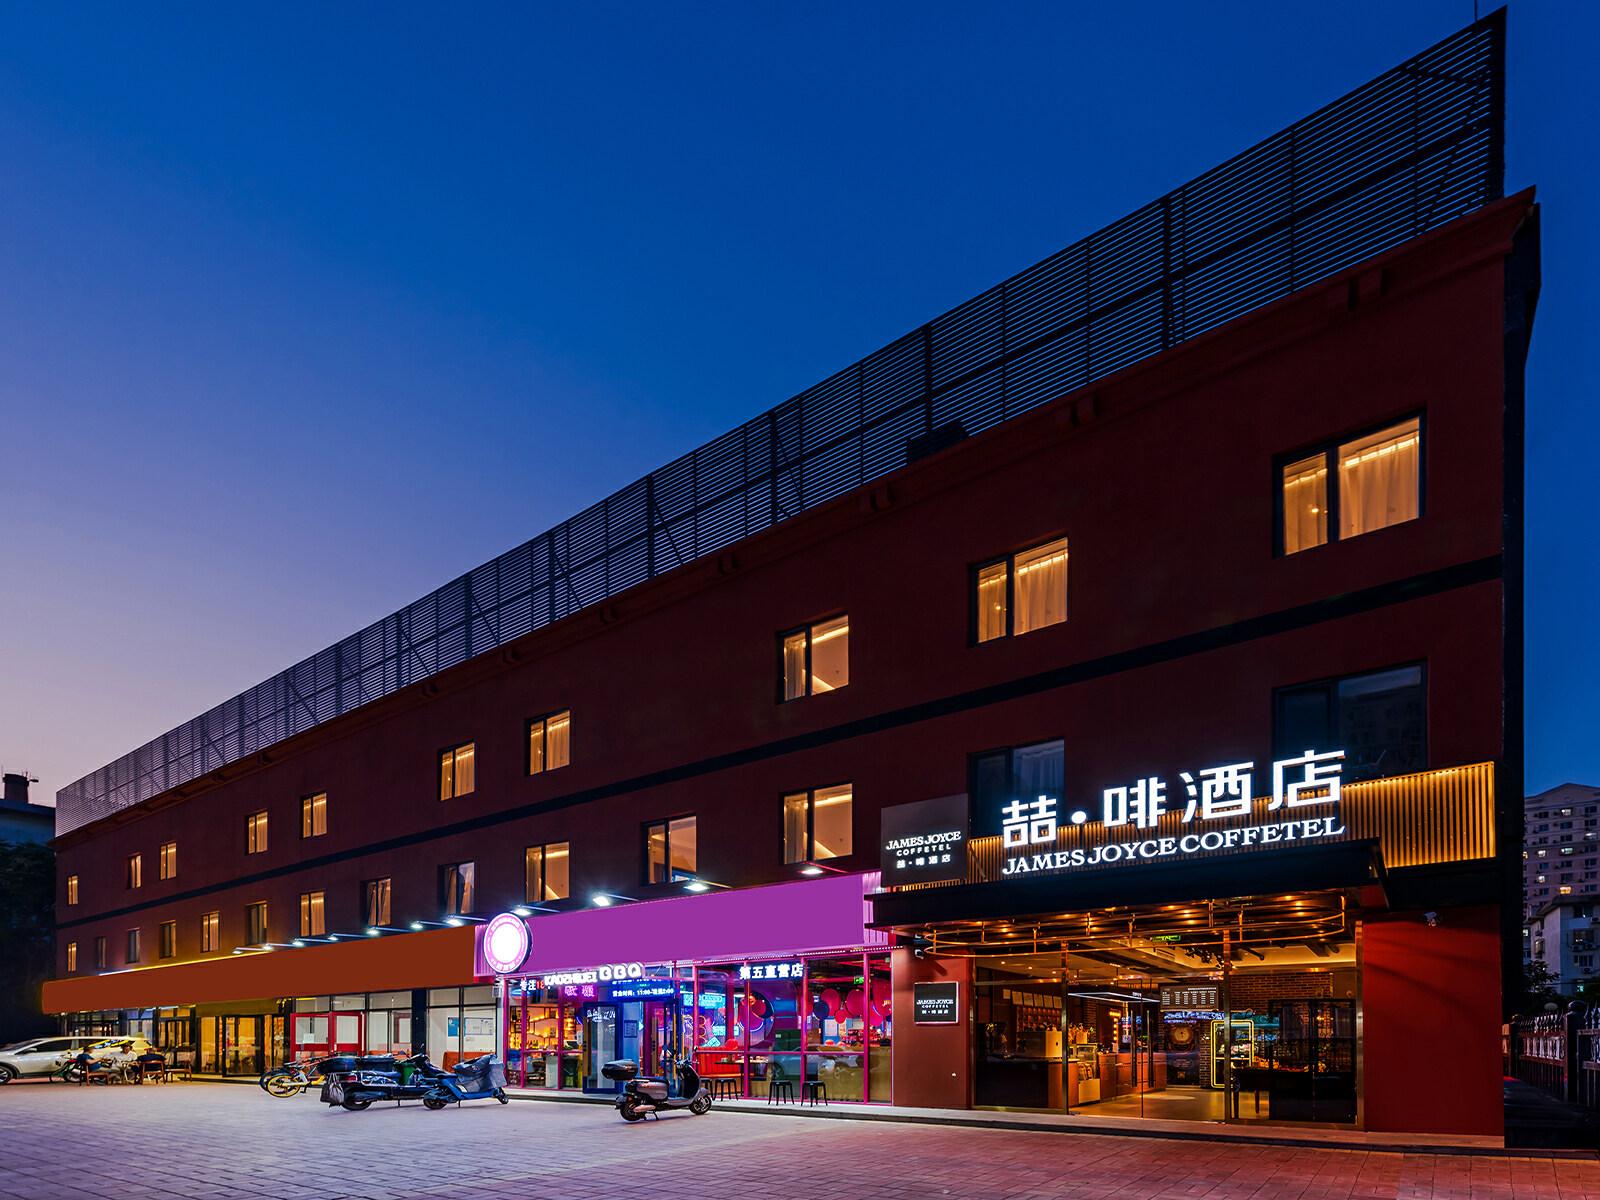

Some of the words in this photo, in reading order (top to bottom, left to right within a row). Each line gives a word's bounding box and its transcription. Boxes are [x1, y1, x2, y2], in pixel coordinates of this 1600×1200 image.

[1002, 750, 1344, 848] 喆·啡酒店
[885, 836, 924, 850] JAMES
[924, 830, 961, 845] JOYCE
[896, 843, 951, 856] COFFETEL
[1002, 849, 1085, 875] JAMES
[1087, 837, 1178, 864] JOYCE
[1179, 817, 1346, 853] COFFETEL
